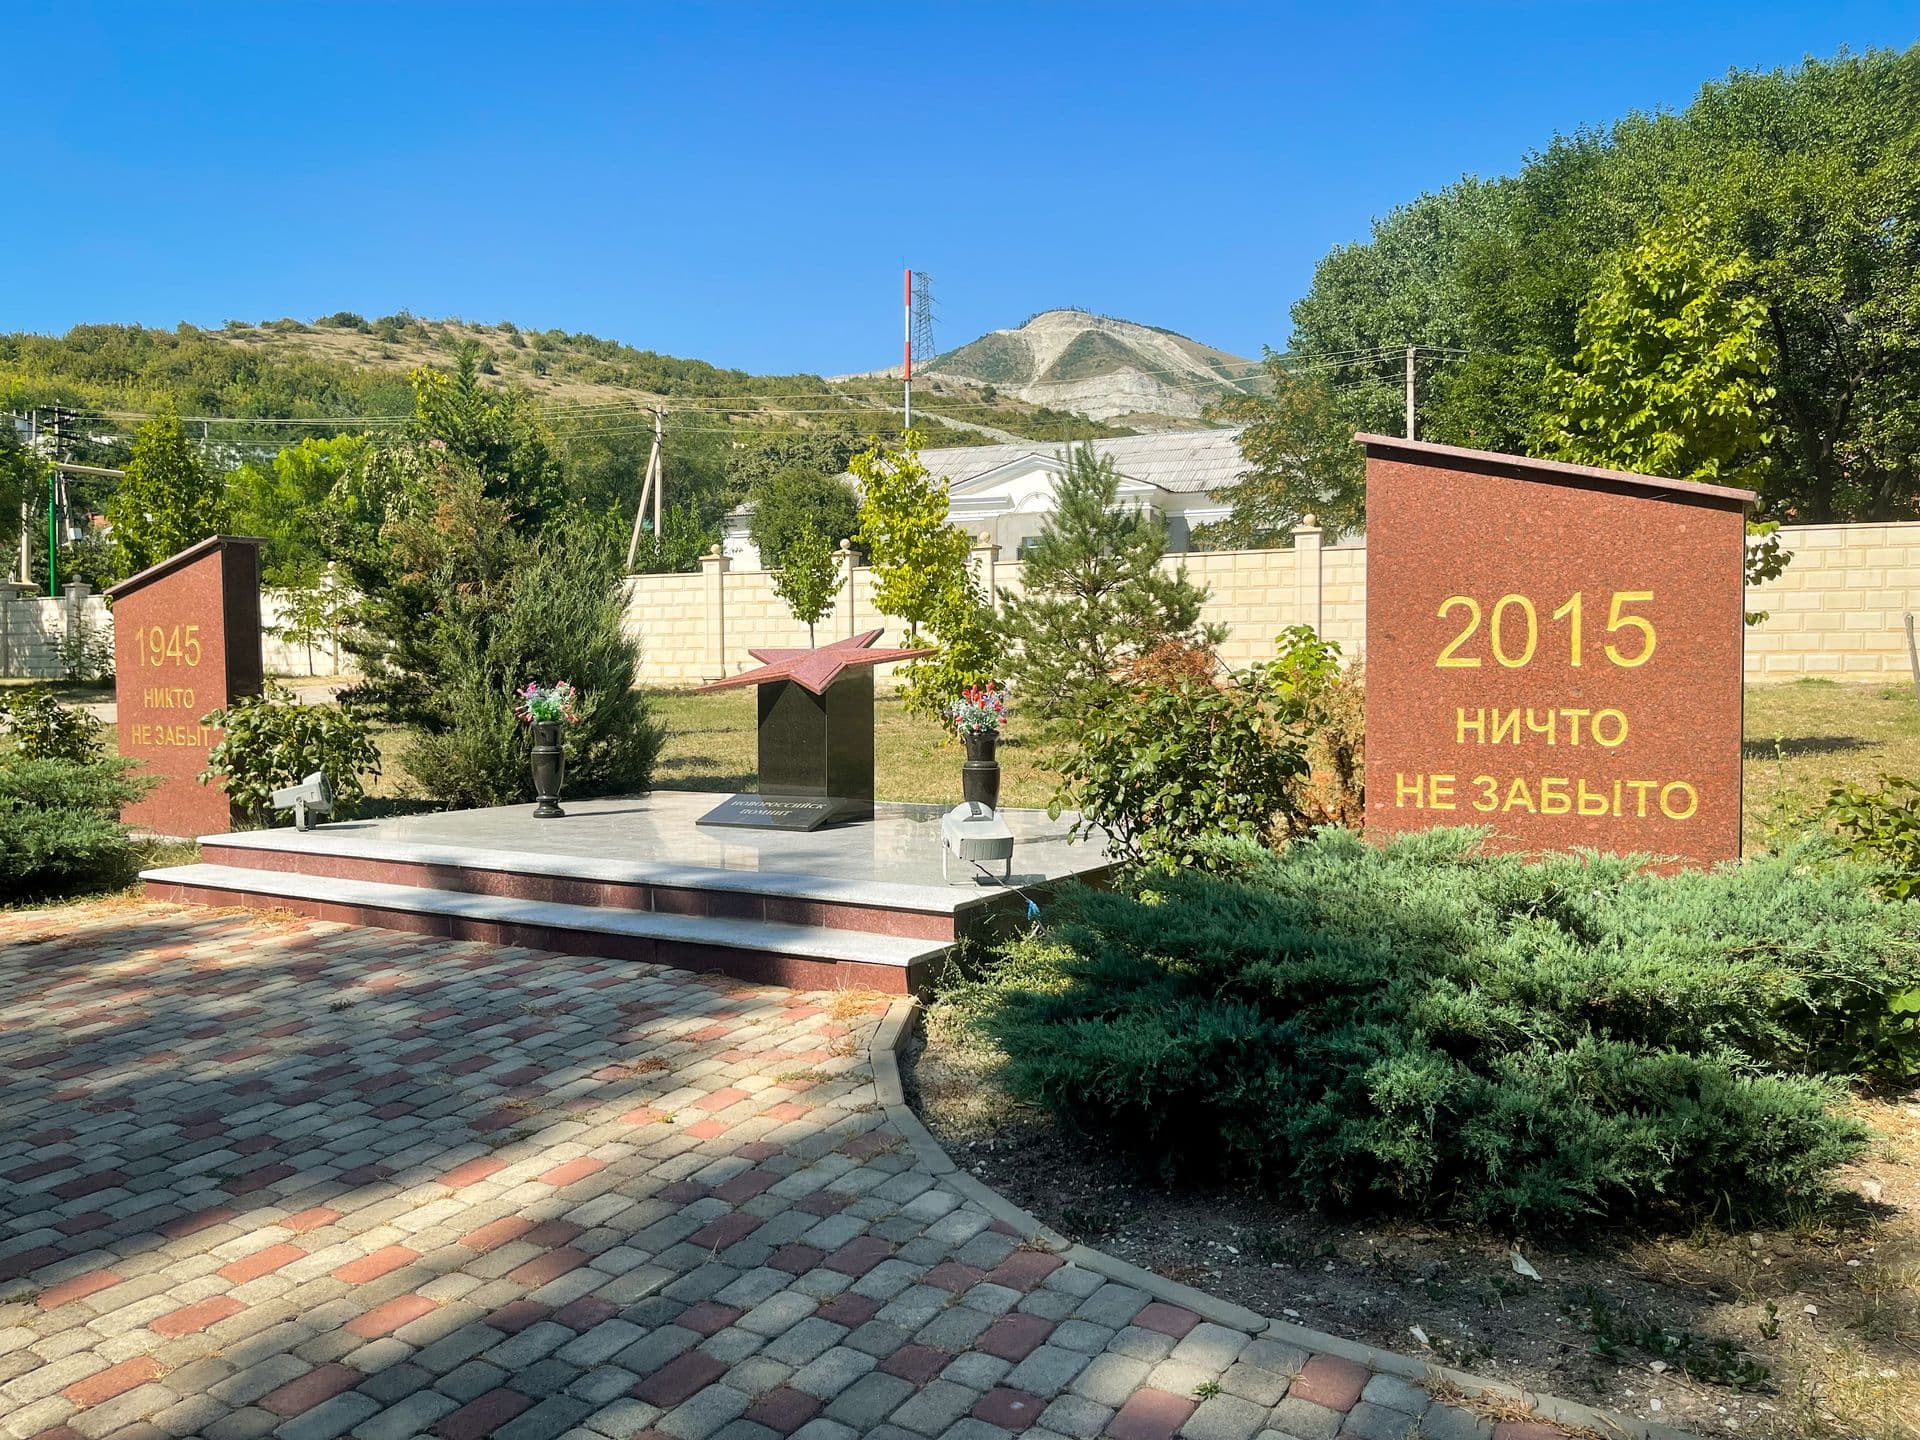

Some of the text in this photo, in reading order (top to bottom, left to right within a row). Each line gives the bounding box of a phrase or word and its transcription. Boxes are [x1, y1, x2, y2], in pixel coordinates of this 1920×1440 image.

[135, 624, 201, 667] 1945
[1434, 590, 1657, 669] 2015
[143, 687, 195, 710] НИКТО
[131, 724, 211, 747] НЕ ЗАБЫТ
[1455, 707, 1630, 748] НИЧТО
[730, 799, 828, 810] НОВОРОССИЙСК
[739, 808, 793, 816] ПОМНИТ
[1395, 772, 1699, 821] НЕ ЗАБЫТО
